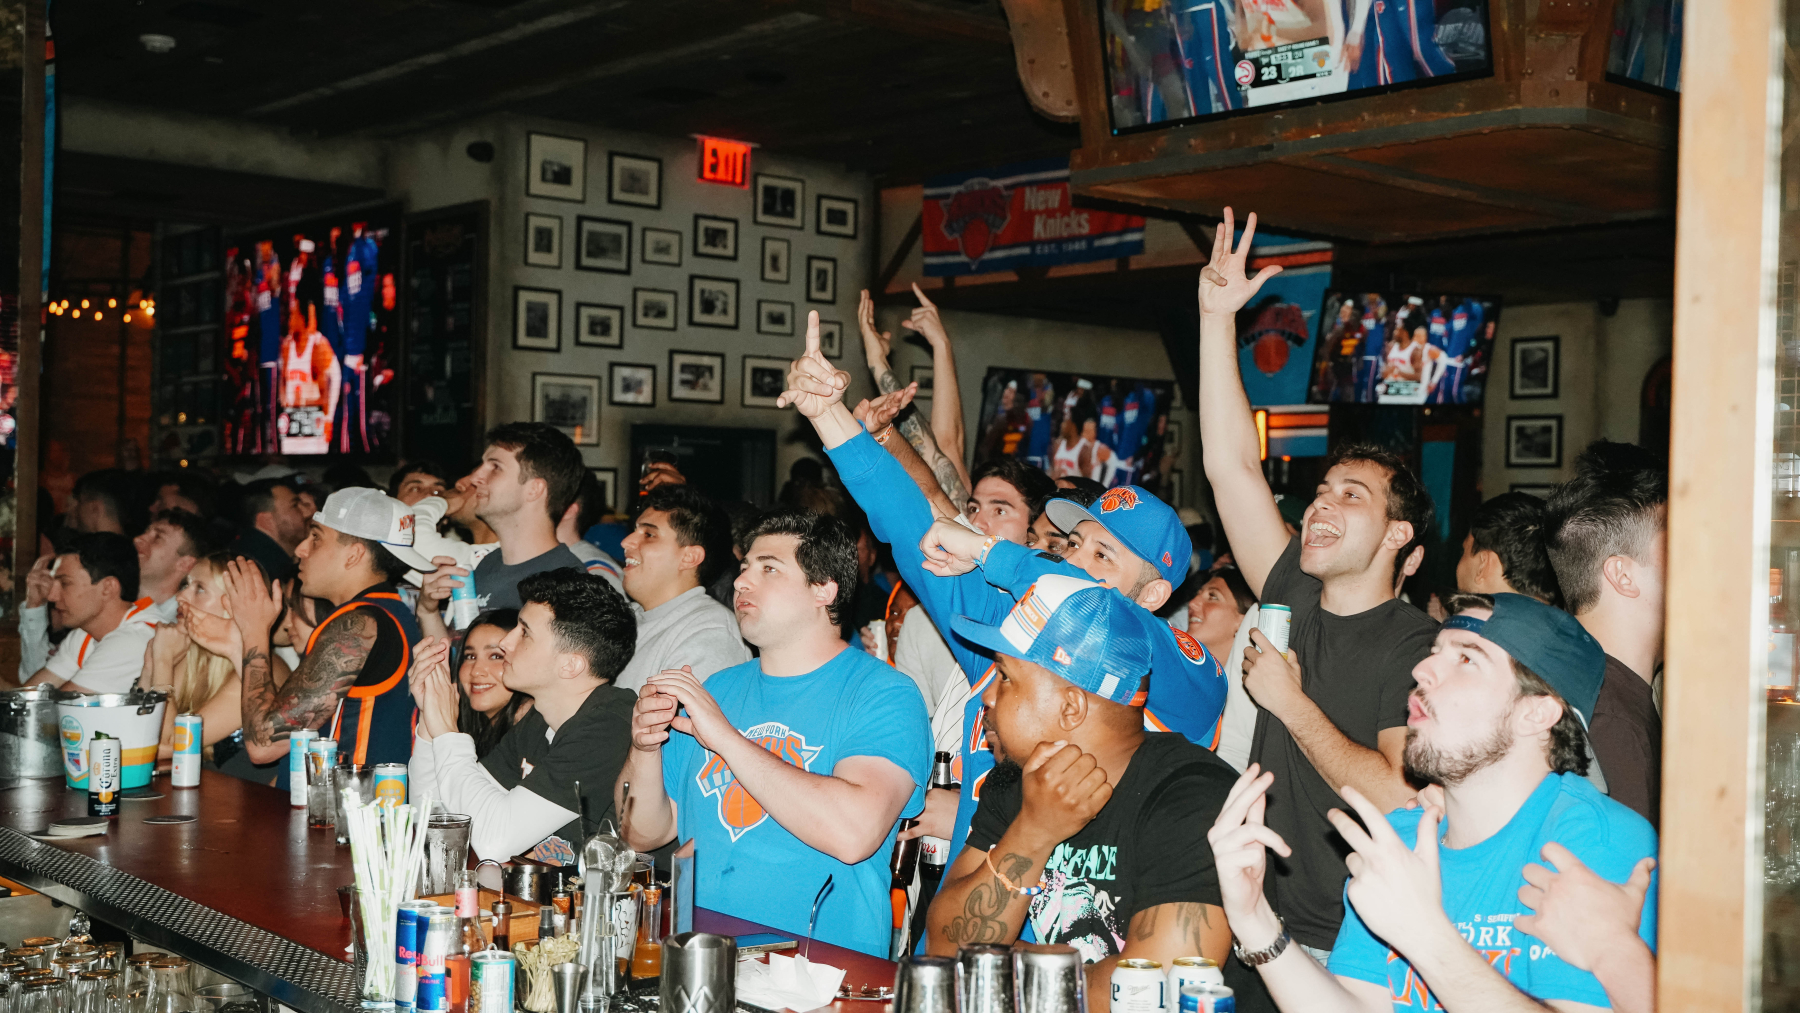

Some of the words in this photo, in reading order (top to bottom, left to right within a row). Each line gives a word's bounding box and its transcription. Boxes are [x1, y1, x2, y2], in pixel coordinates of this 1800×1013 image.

[1261, 66, 1277, 81] 23
[703, 140, 747, 184] EXIT
[1024, 185, 1062, 212] New
[1032, 209, 1090, 240] Knicks
[746, 726, 765, 738] NEW
[765, 724, 788, 738] YORK
[99, 748, 113, 790] Corona
[110, 757, 118, 780] Extra
